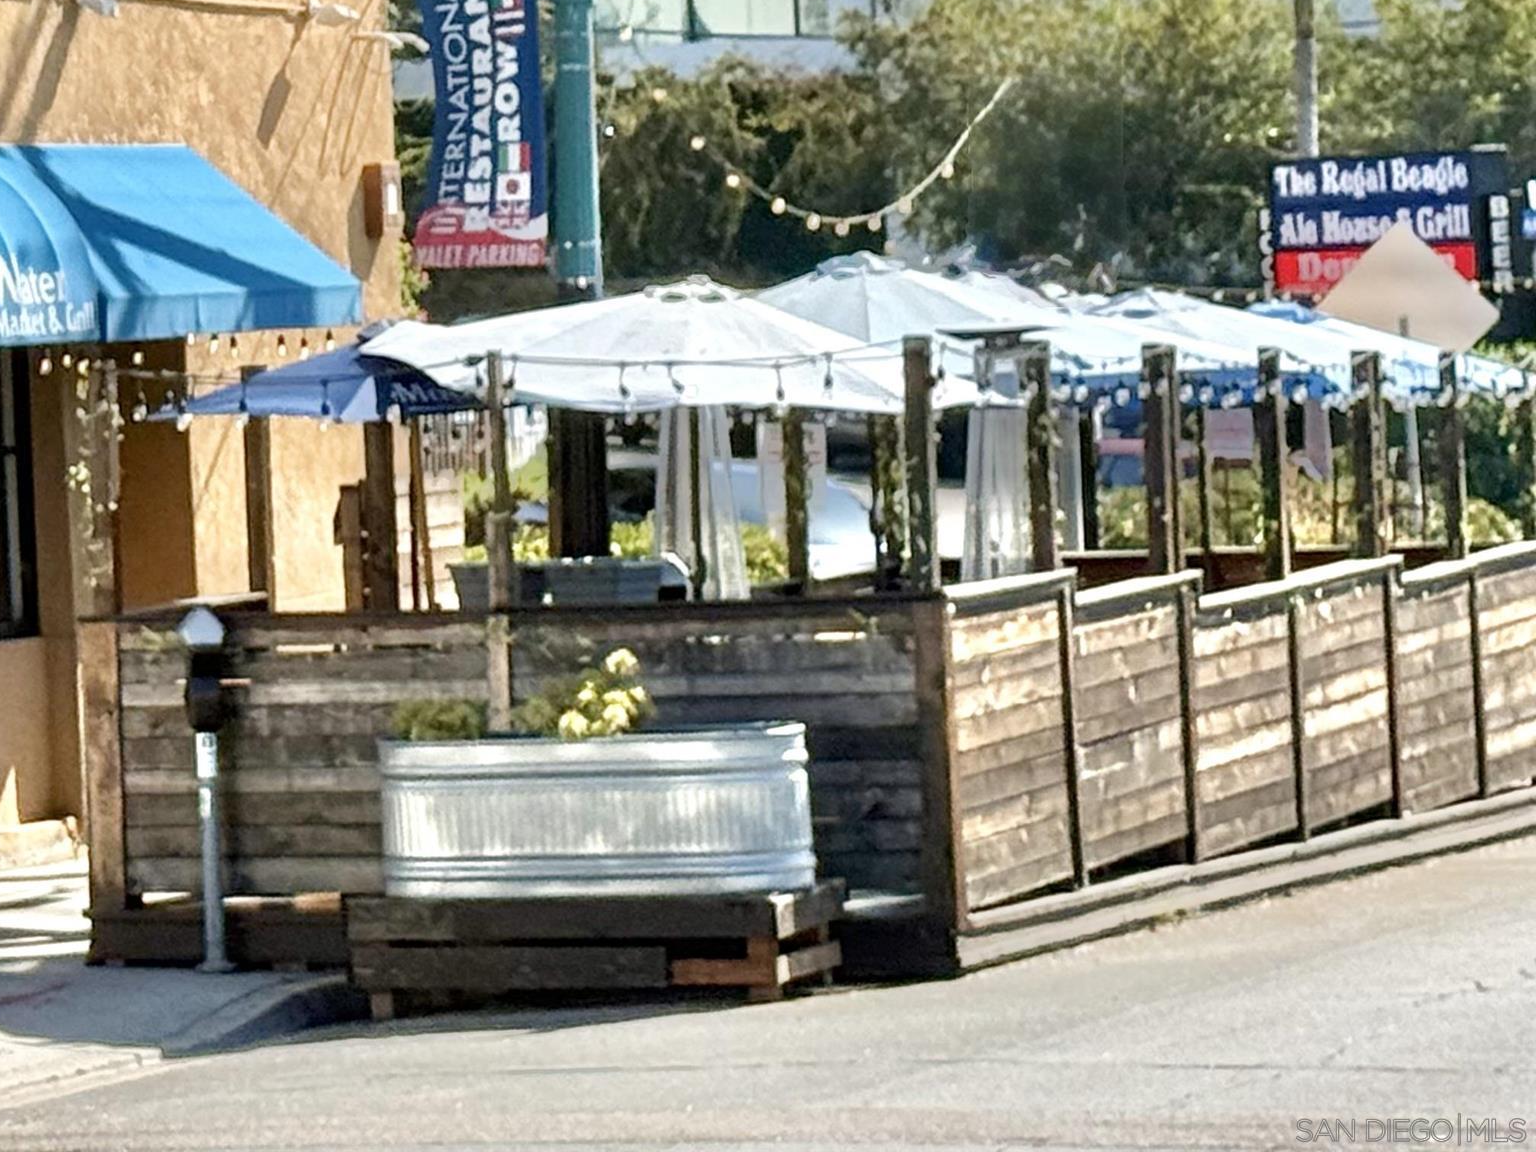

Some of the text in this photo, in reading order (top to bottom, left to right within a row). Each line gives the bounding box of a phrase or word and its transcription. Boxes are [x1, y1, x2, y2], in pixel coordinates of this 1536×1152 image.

[494, 40, 521, 143] ROW
[1273, 155, 1469, 200] The Regal Beagle
[1279, 211, 1319, 246] Ale
[1416, 203, 1471, 241] Grill
[467, 242, 541, 267] PARKING
[48, 304, 64, 335] &
